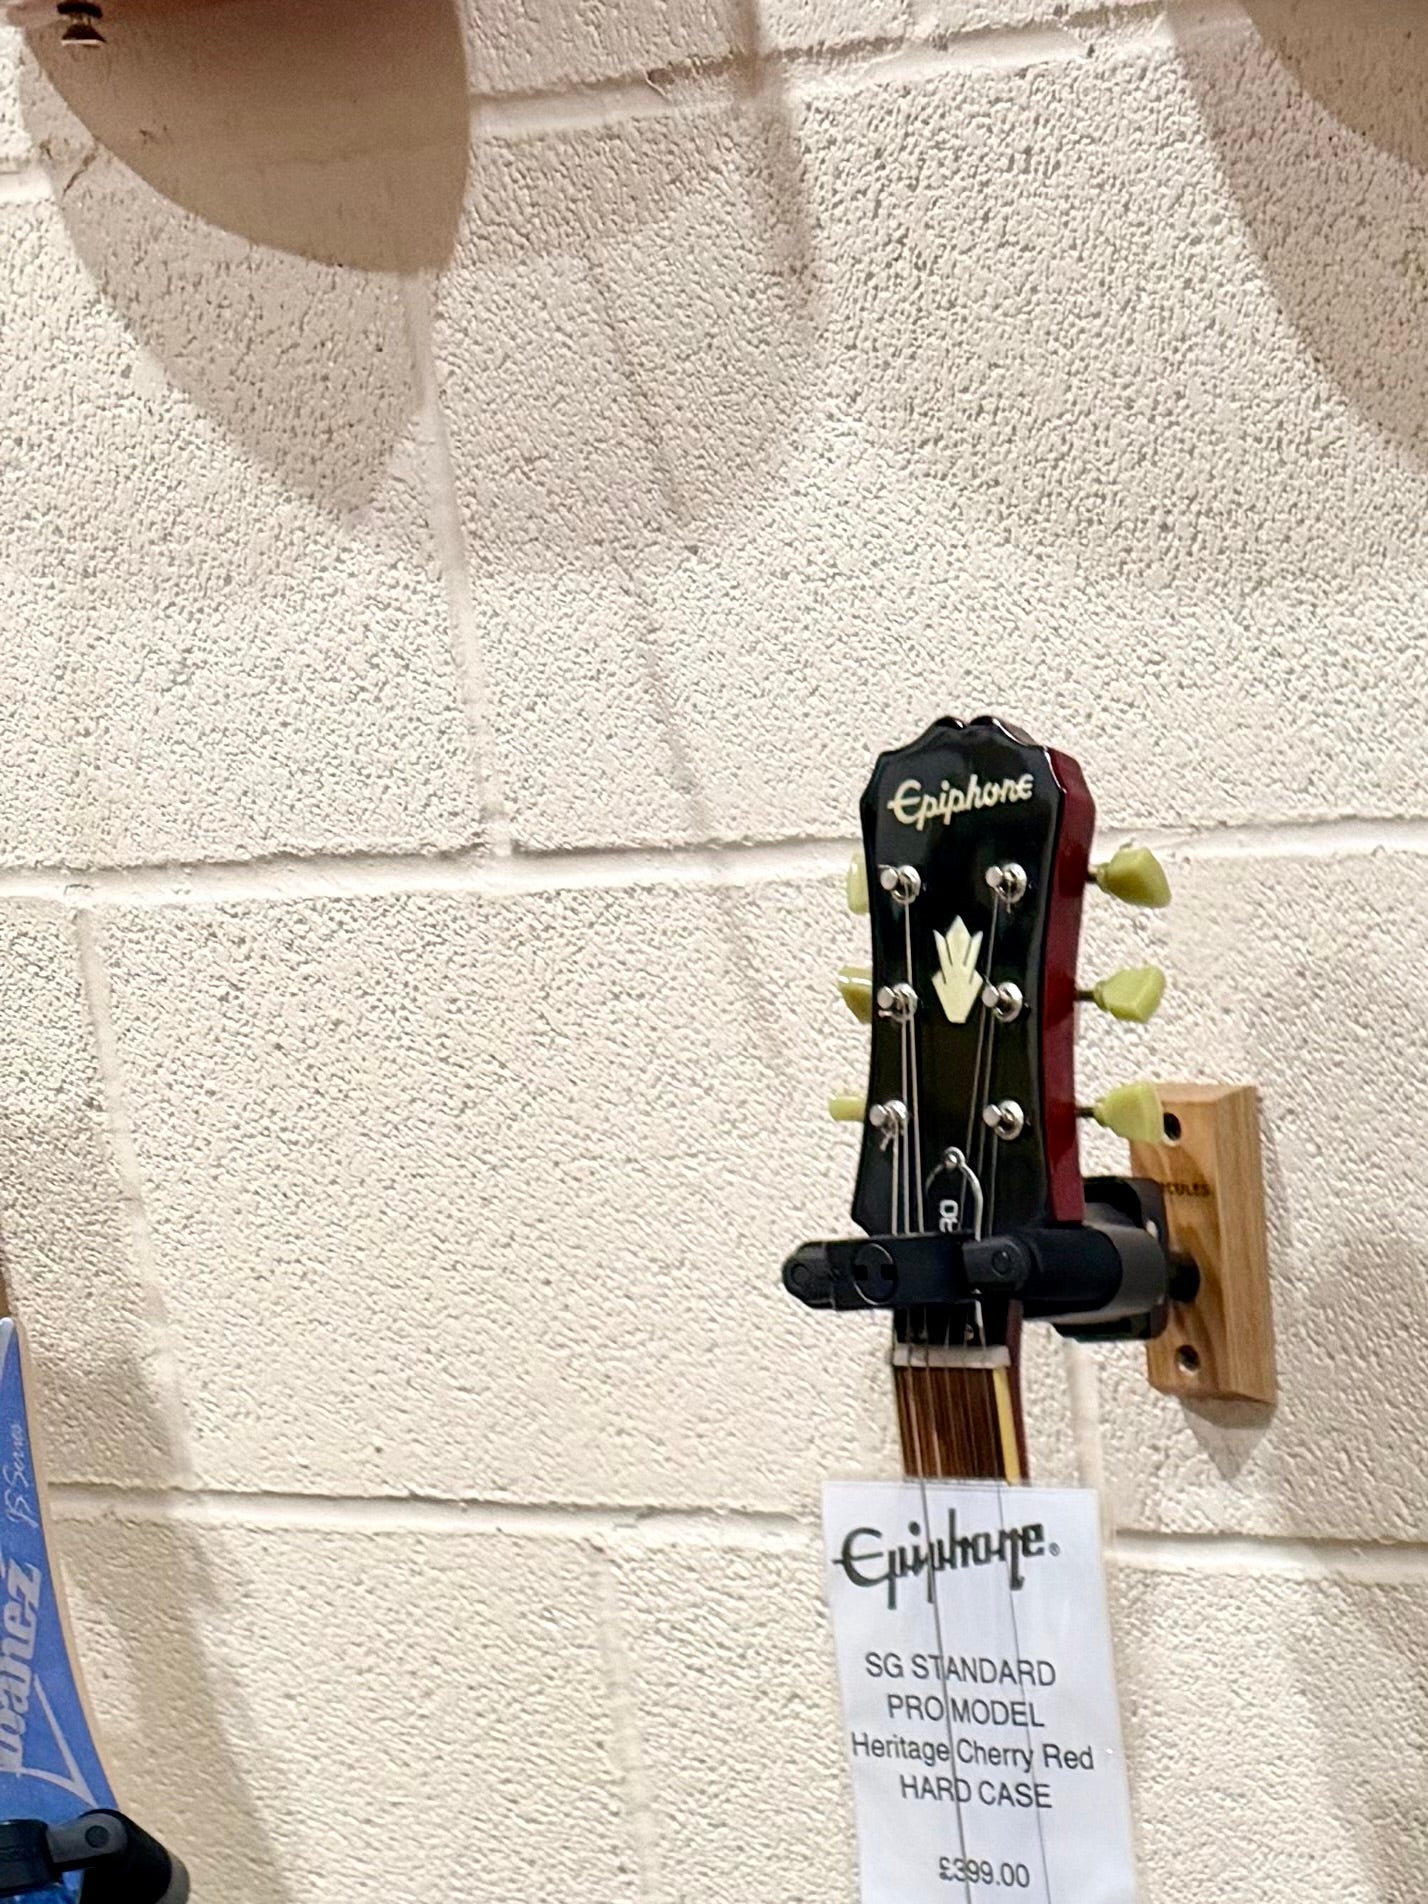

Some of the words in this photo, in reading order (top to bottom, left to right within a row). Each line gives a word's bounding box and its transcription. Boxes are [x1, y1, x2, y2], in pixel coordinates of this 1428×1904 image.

[887, 774, 1034, 831] Epiphone
[1161, 1182, 1211, 1197] CULES
[865, 1652, 904, 1678] SG
[911, 1654, 1056, 1686] STANDARD
[887, 1694, 944, 1721] PRO
[951, 1698, 1045, 1727] MODEL
[851, 1732, 950, 1767] Heritage
[956, 1738, 1034, 1773] Cherry
[1042, 1743, 1094, 1770] Red
[900, 1775, 971, 1803] HARD
[978, 1781, 1052, 1808] CASE
[940, 1857, 1030, 1888] £399.00
